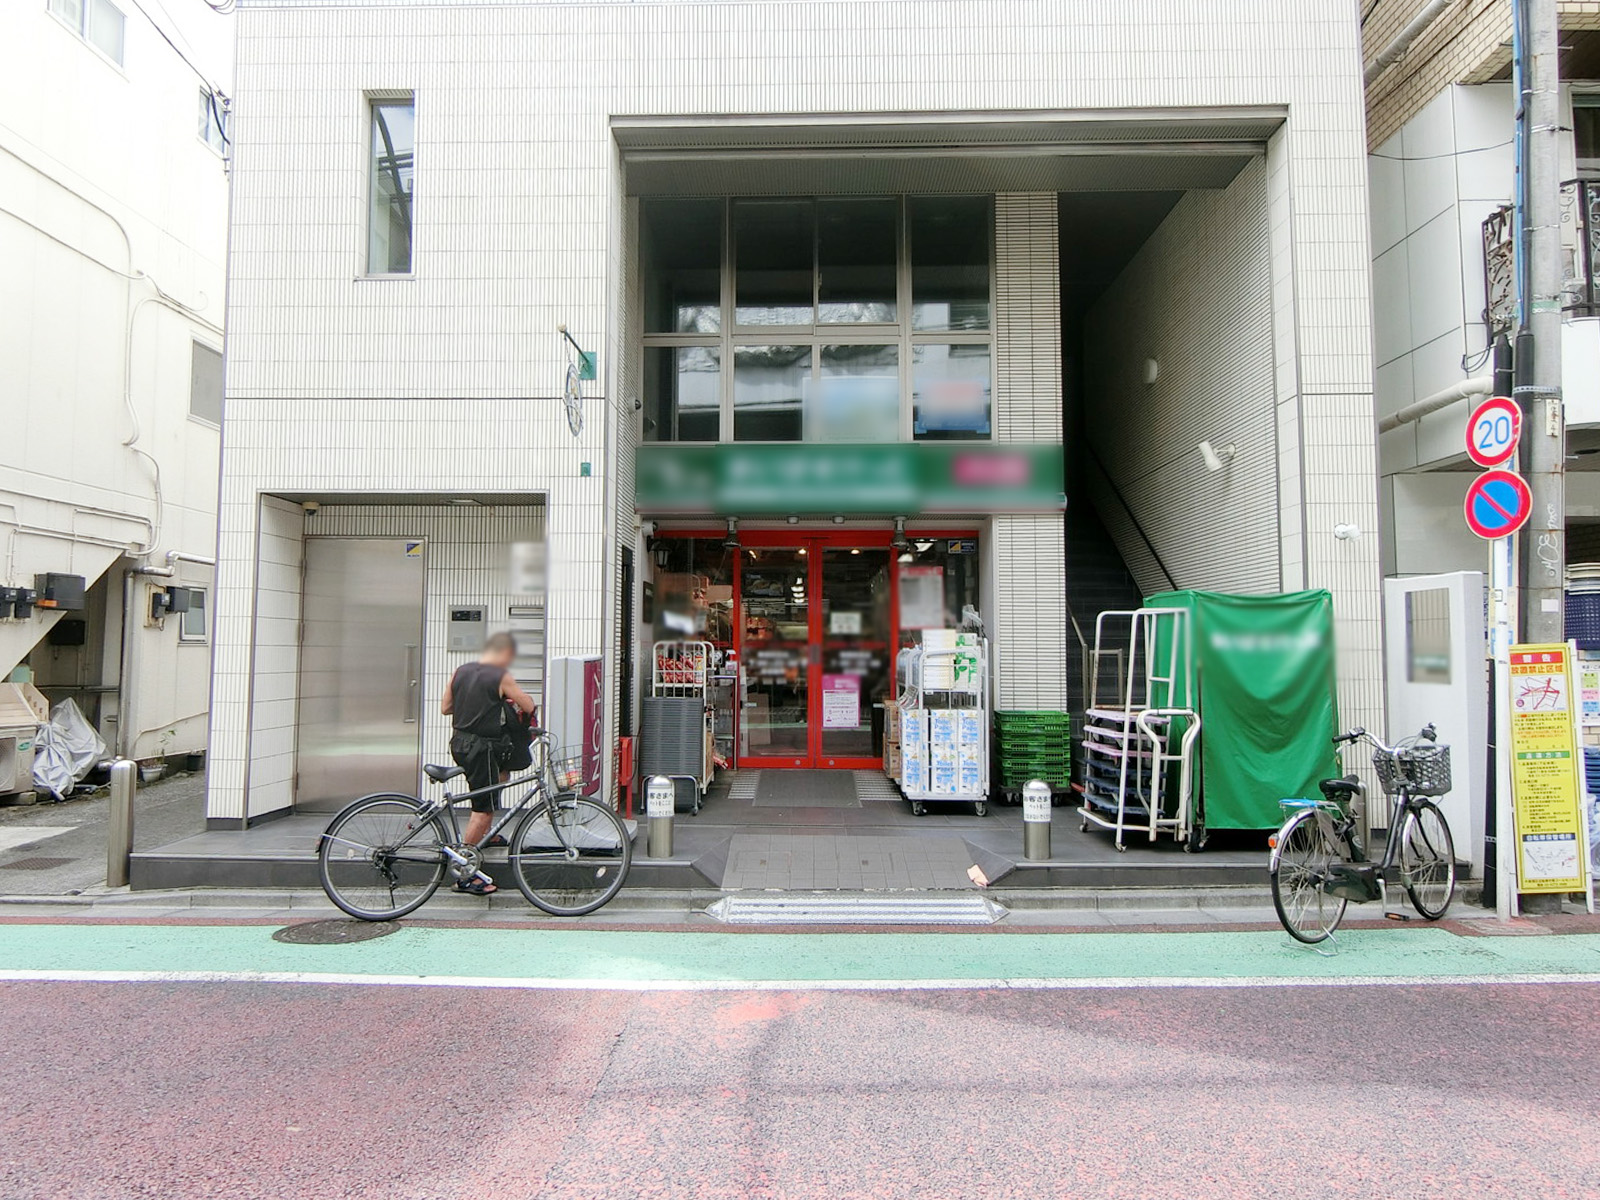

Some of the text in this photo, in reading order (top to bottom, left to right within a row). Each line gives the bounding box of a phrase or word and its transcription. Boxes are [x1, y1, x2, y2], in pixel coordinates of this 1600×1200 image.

[1478, 415, 1511, 450] 20
[1511, 664, 1563, 675] 放置禁止区域
